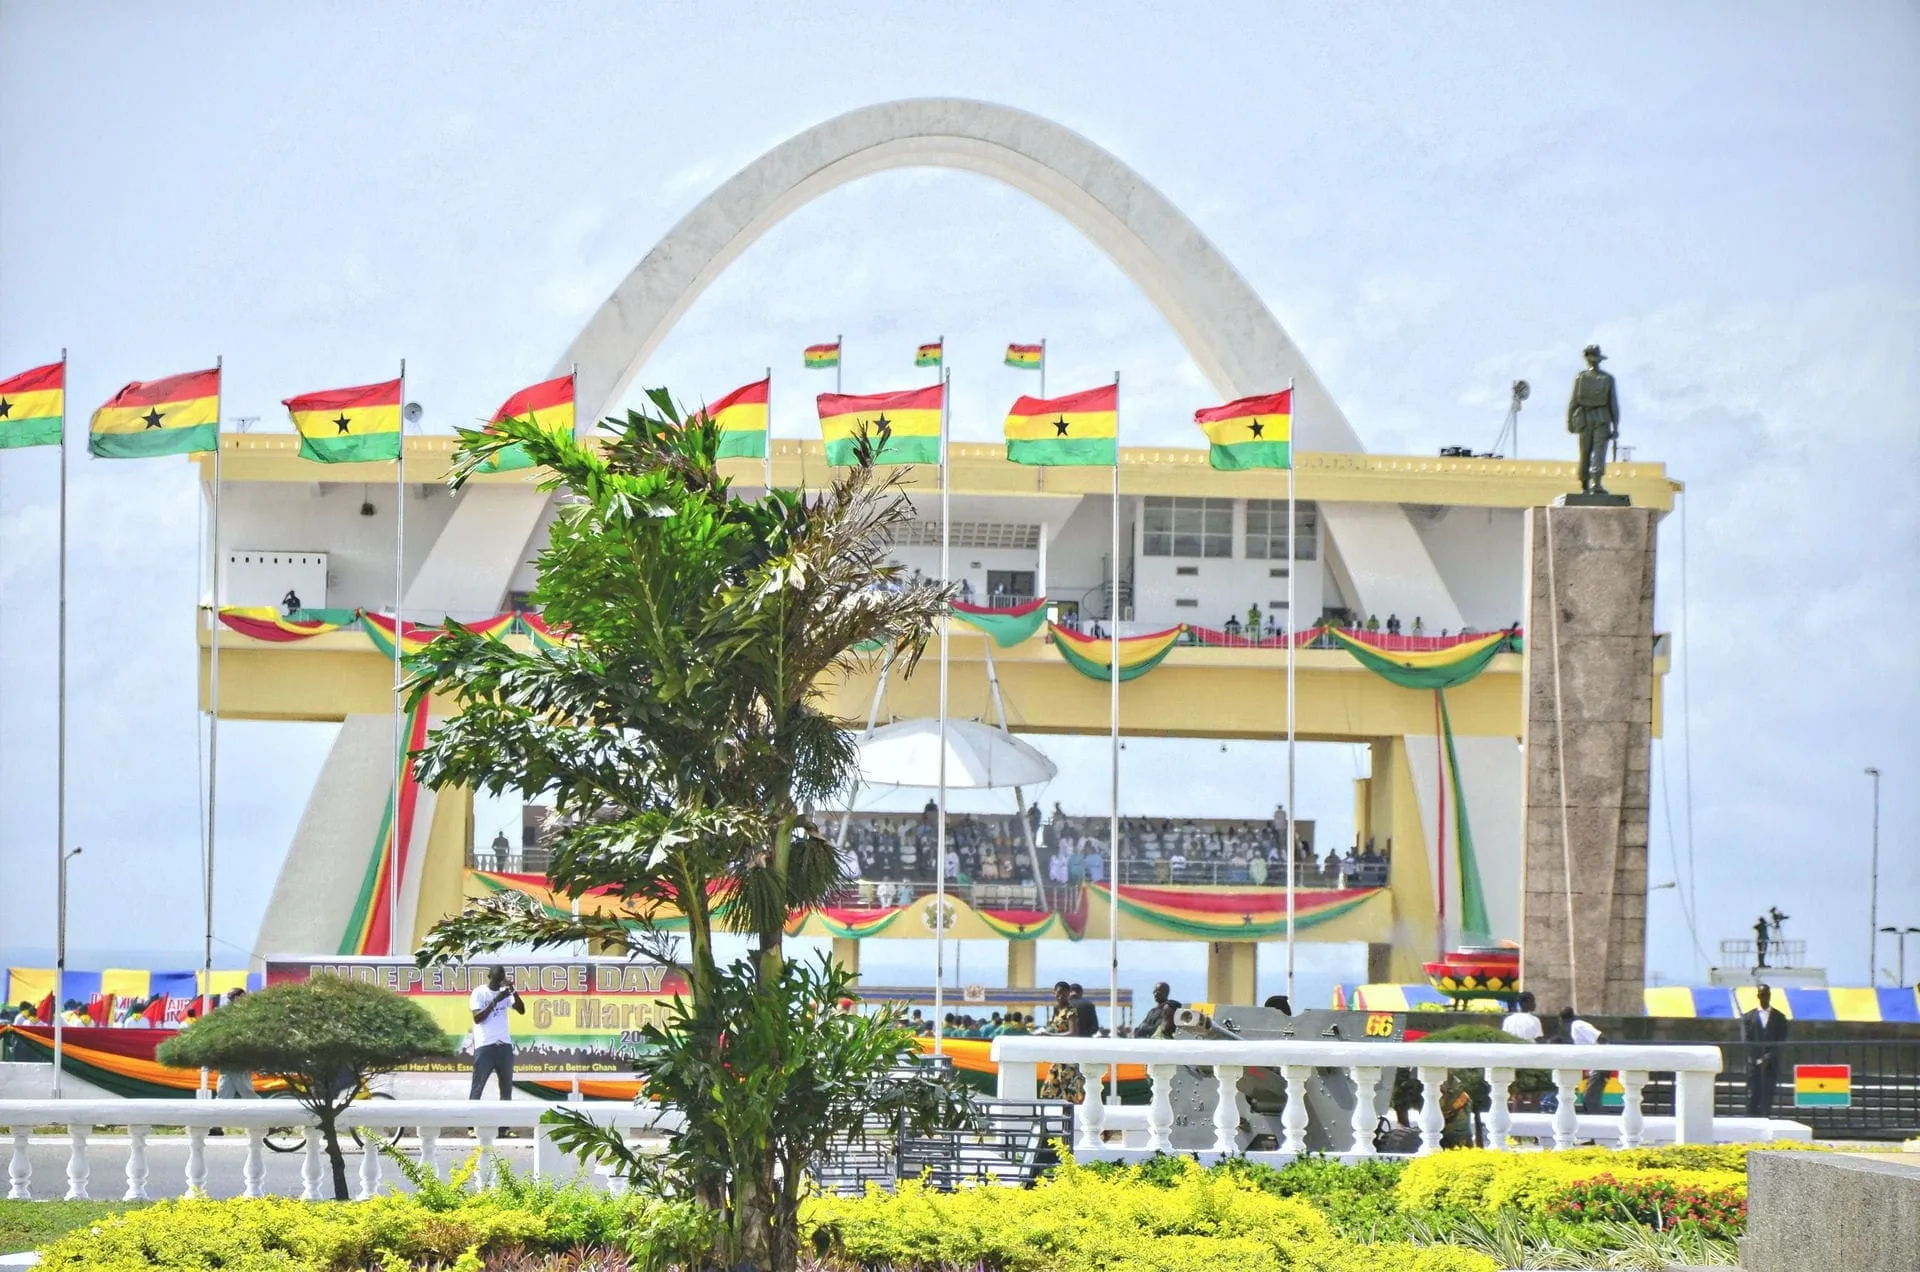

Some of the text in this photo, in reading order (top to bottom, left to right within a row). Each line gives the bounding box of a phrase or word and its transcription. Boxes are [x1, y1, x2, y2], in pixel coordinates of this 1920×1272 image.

[596, 965, 668, 992] DAY
[533, 998, 671, 1029] 6th March
[1366, 1014, 1394, 1037] 66
[409, 1063, 429, 1071] Hard
[431, 1063, 455, 1071] Work:
[513, 1064, 542, 1073] quisites
[565, 1063, 591, 1071] Better
[592, 1063, 617, 1071] Ghana
